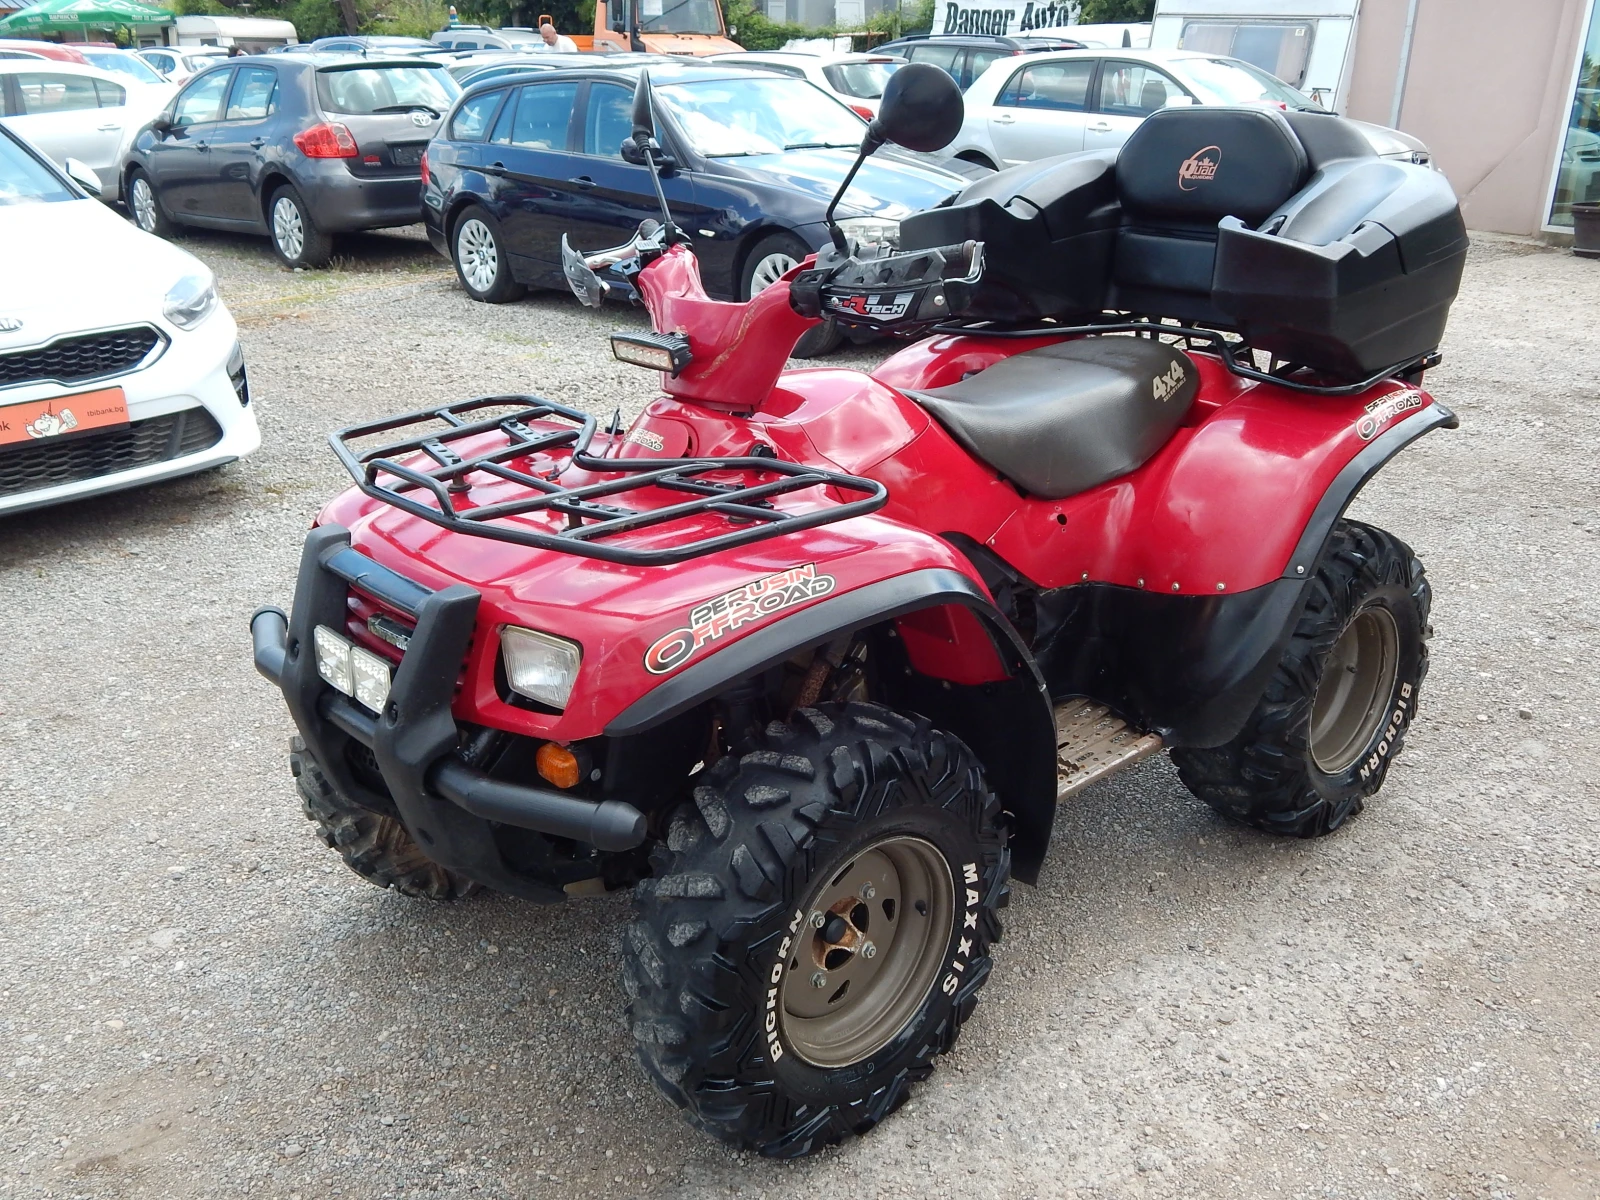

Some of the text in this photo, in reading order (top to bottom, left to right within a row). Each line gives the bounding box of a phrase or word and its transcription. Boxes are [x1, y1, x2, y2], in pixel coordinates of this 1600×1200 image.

[87, 405, 124, 417] tbibank.bg
[644, 575, 836, 674] OFFROAD
[690, 563, 816, 626] PERUSIN
[1360, 682, 1412, 781] BIGHORN
[942, 863, 979, 996] MAXXIS
[765, 909, 803, 1063] BIGHORN
